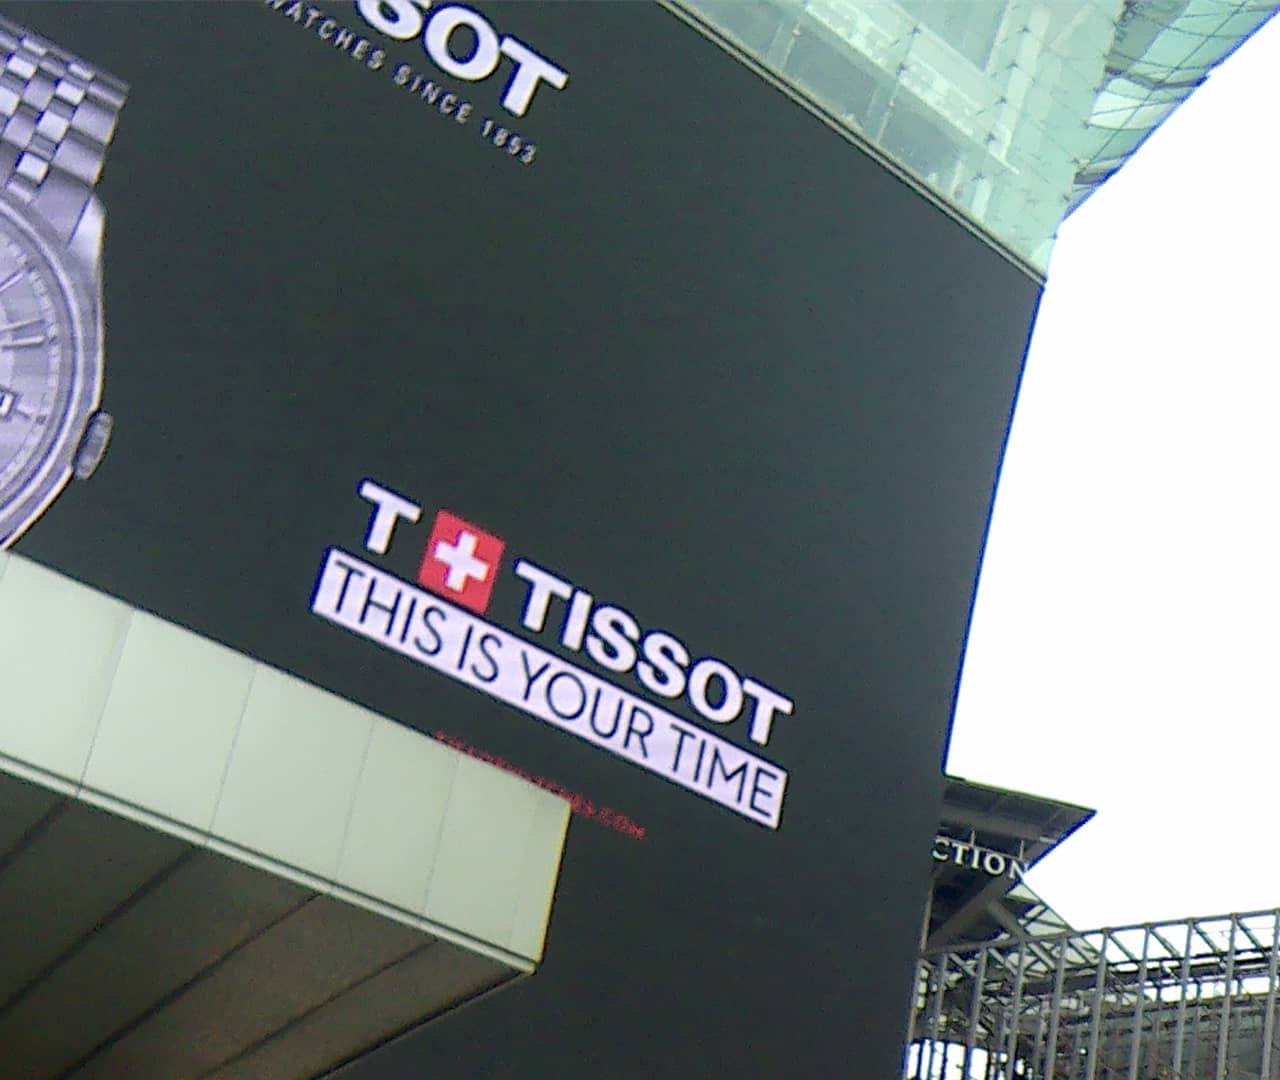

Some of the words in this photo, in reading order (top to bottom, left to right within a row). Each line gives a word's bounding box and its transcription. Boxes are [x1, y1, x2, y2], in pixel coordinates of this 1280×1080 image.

[392, 62, 474, 124] SINCE
[335, 559, 447, 657] THIS
[456, 624, 502, 684] IS
[520, 650, 657, 759] YOUR
[670, 722, 779, 819] TIME
[514, 557, 795, 746] TISSOT
